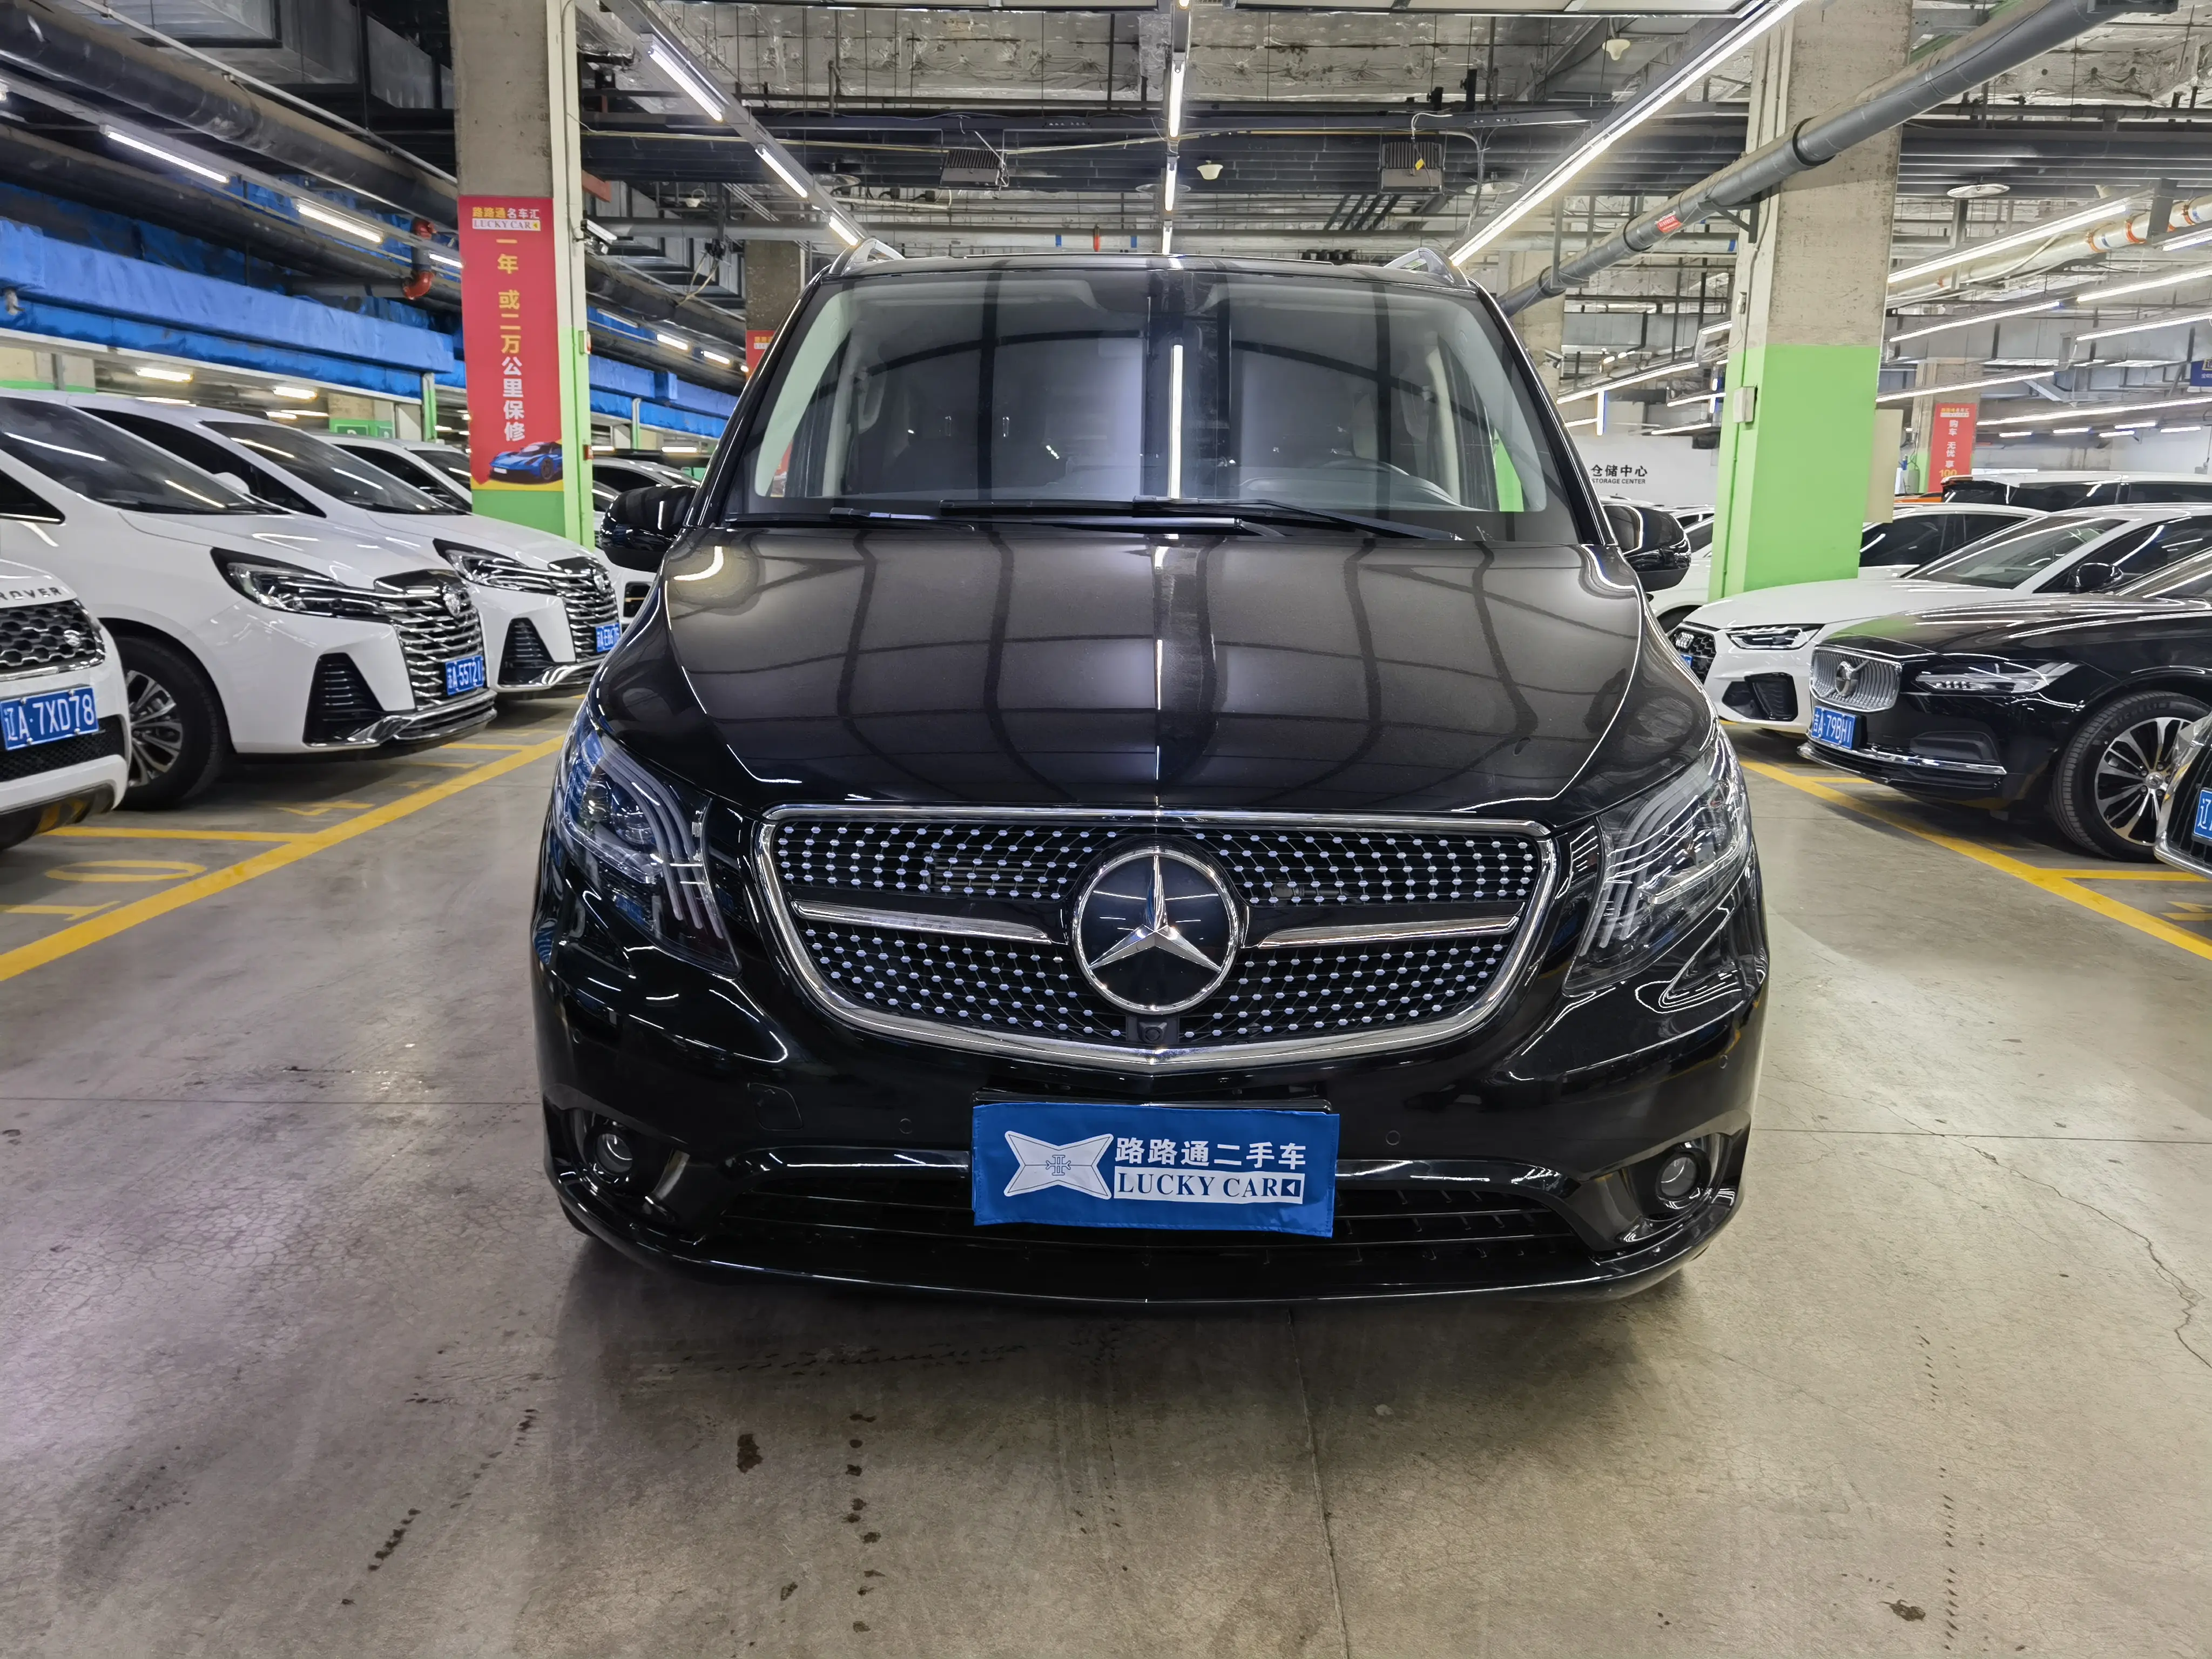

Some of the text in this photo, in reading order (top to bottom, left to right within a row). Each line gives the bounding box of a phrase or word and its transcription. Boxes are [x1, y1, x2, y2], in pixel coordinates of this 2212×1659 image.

[474, 219, 531, 229] LUCKY CAR
[1590, 464, 1648, 477] 仓储中心
[1115, 1137, 1306, 1170] 路路通二手车
[1118, 1172, 1278, 1198] LUCKY CAR
